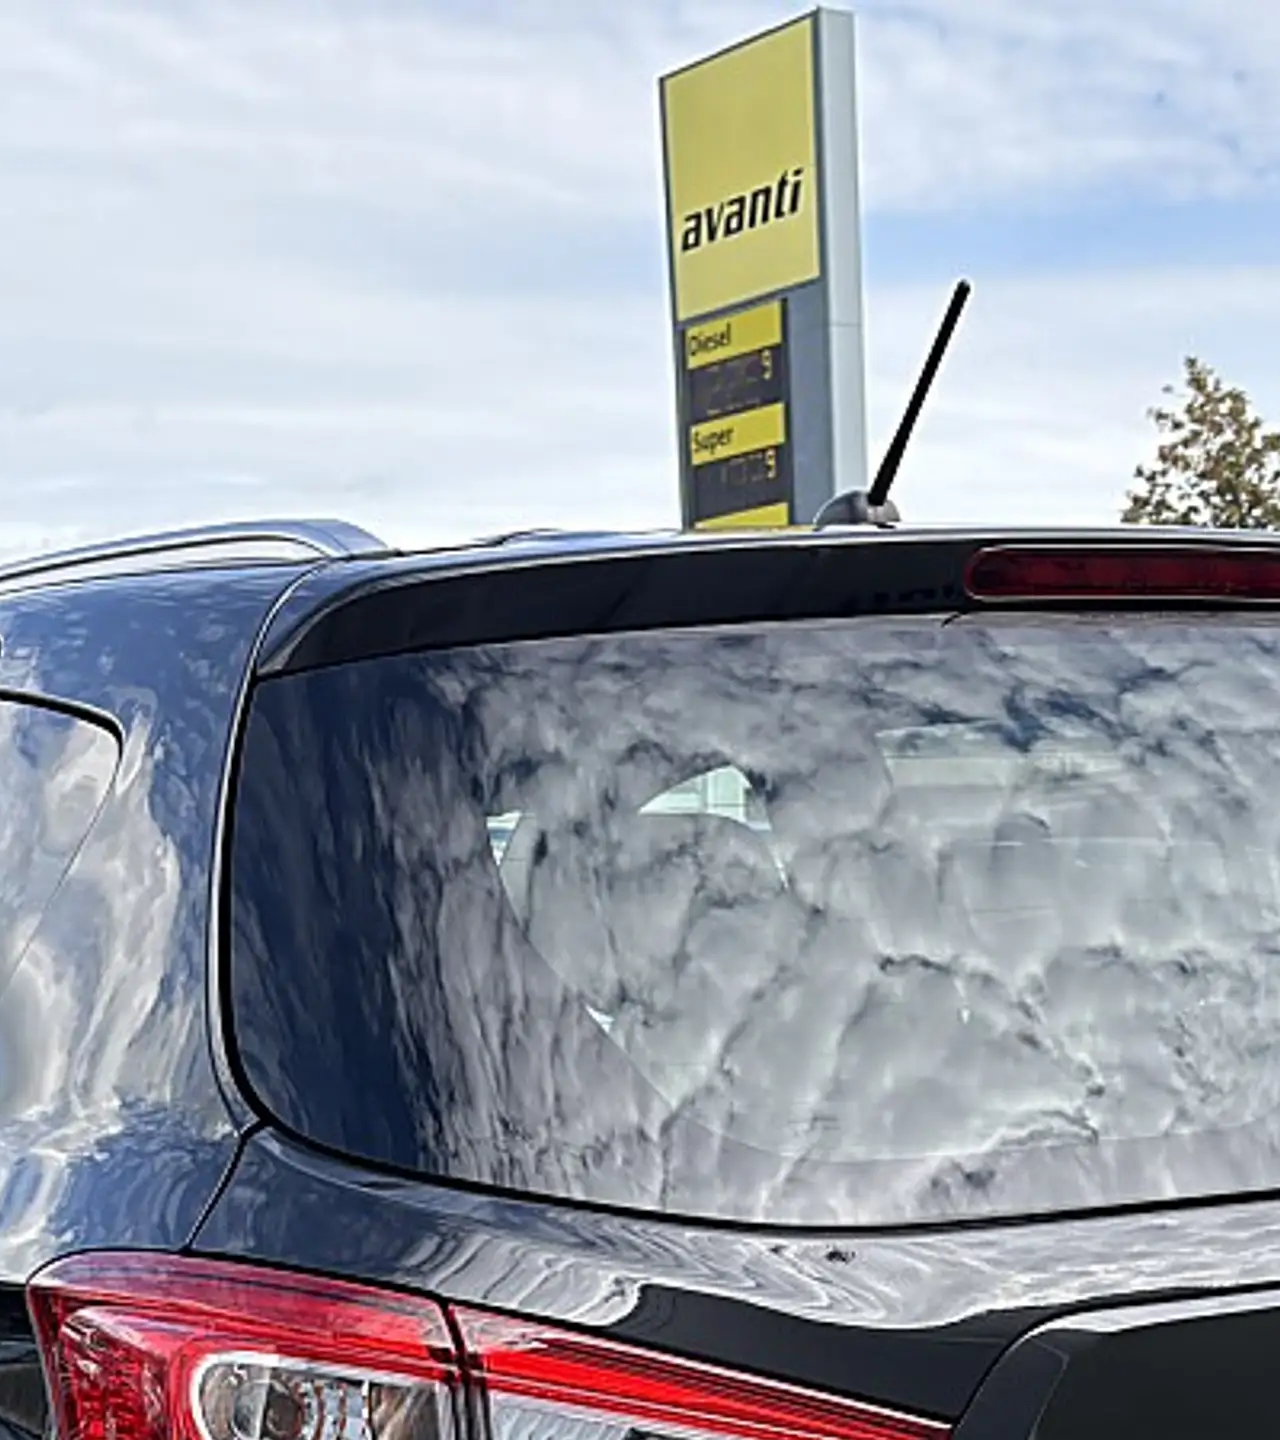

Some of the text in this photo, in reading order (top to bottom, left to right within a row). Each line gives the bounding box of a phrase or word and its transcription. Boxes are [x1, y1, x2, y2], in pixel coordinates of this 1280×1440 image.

[681, 166, 804, 252] avanti
[688, 320, 732, 357] Diesel
[693, 426, 736, 456] Super
